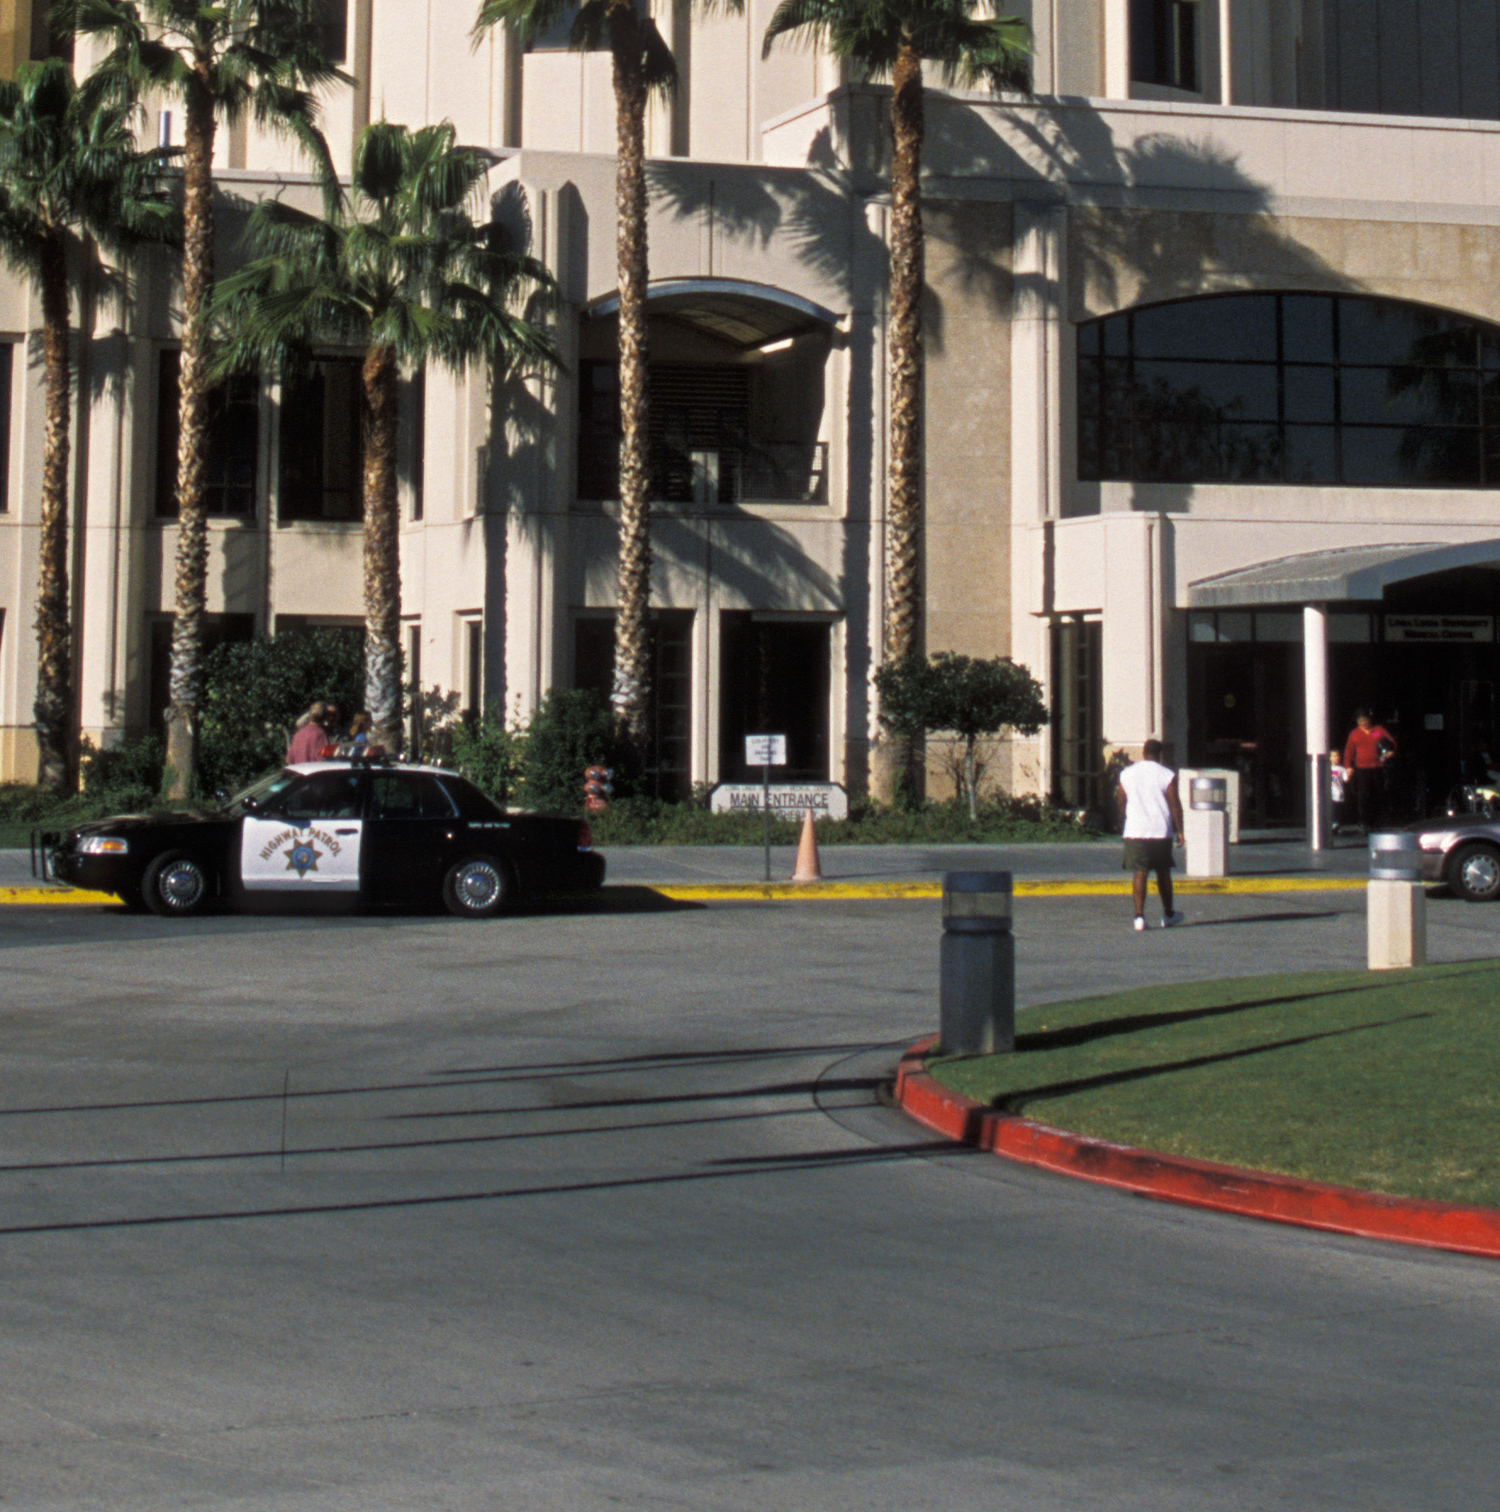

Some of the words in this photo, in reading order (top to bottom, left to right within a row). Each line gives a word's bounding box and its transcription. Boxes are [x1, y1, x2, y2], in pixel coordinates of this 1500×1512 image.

[731, 793, 760, 806] MAIN
[260, 828, 304, 860] HIGHWAY
[308, 827, 342, 857] PATROL
